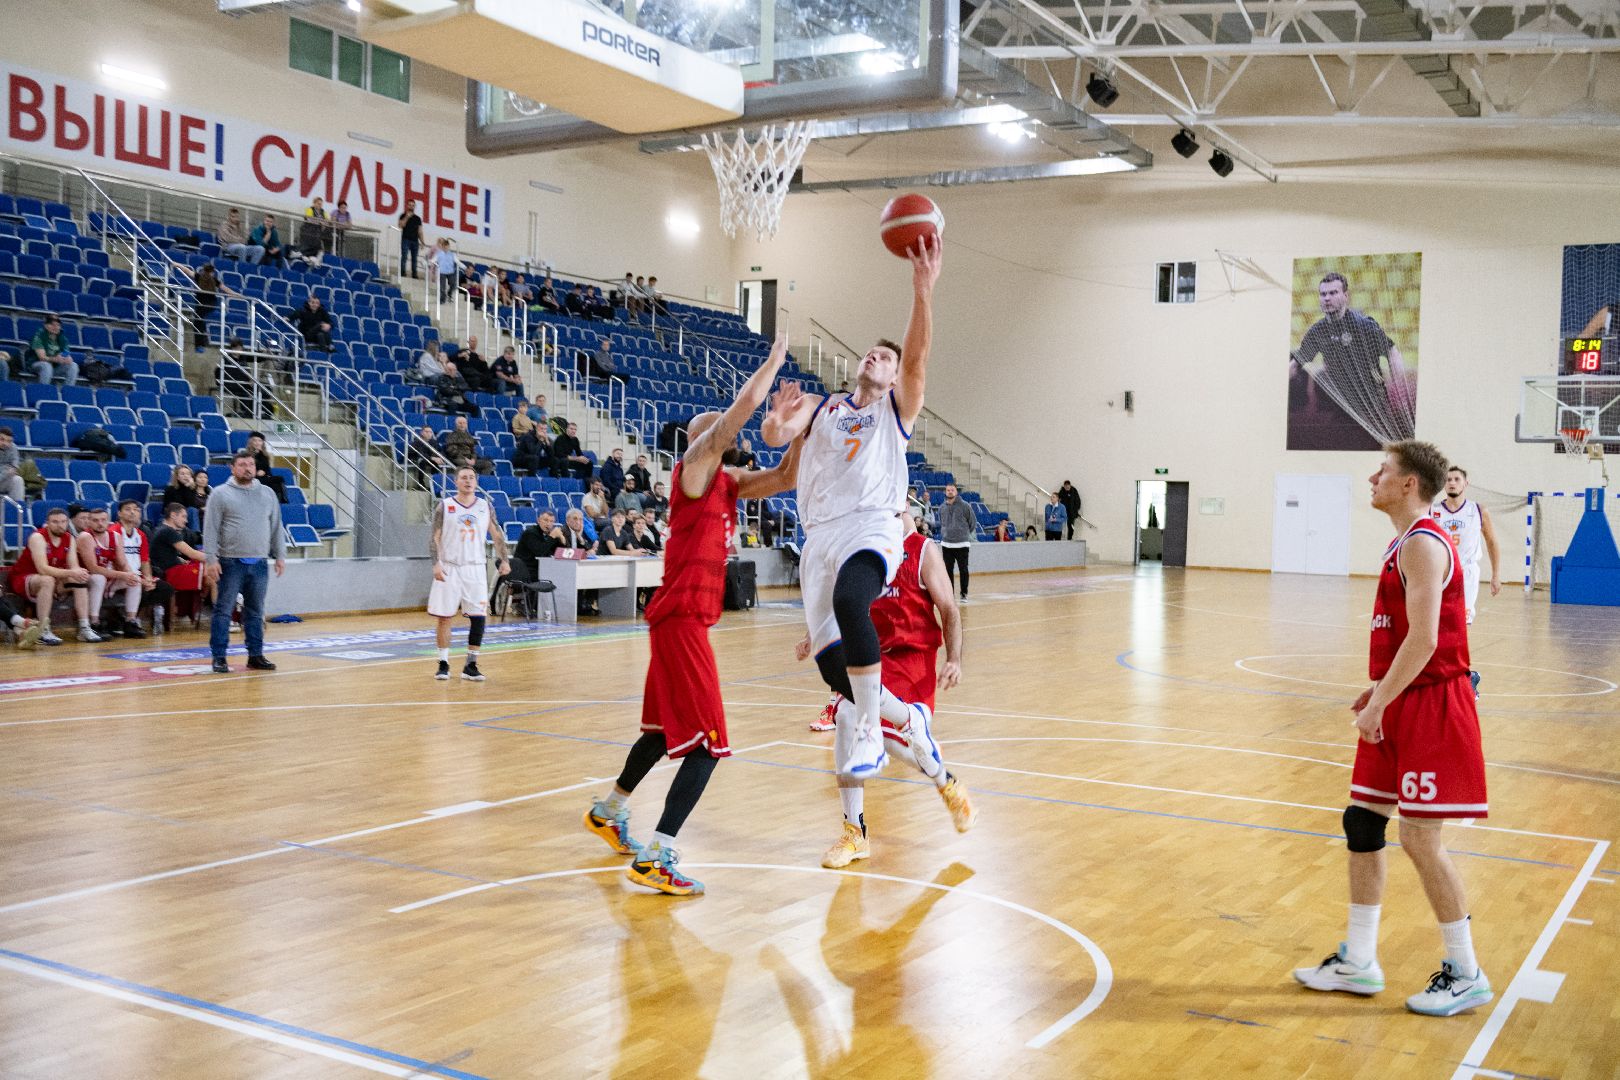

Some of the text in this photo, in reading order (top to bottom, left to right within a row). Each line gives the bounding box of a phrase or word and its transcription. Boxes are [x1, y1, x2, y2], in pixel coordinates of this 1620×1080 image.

[9, 73, 491, 237] ВЫШЕ! СИЛЬНЕЕ!
[1572, 339, 1602, 351] 8:14
[1582, 351, 1598, 370] 18
[844, 438, 861, 462] 7
[1401, 771, 1438, 801] 65
